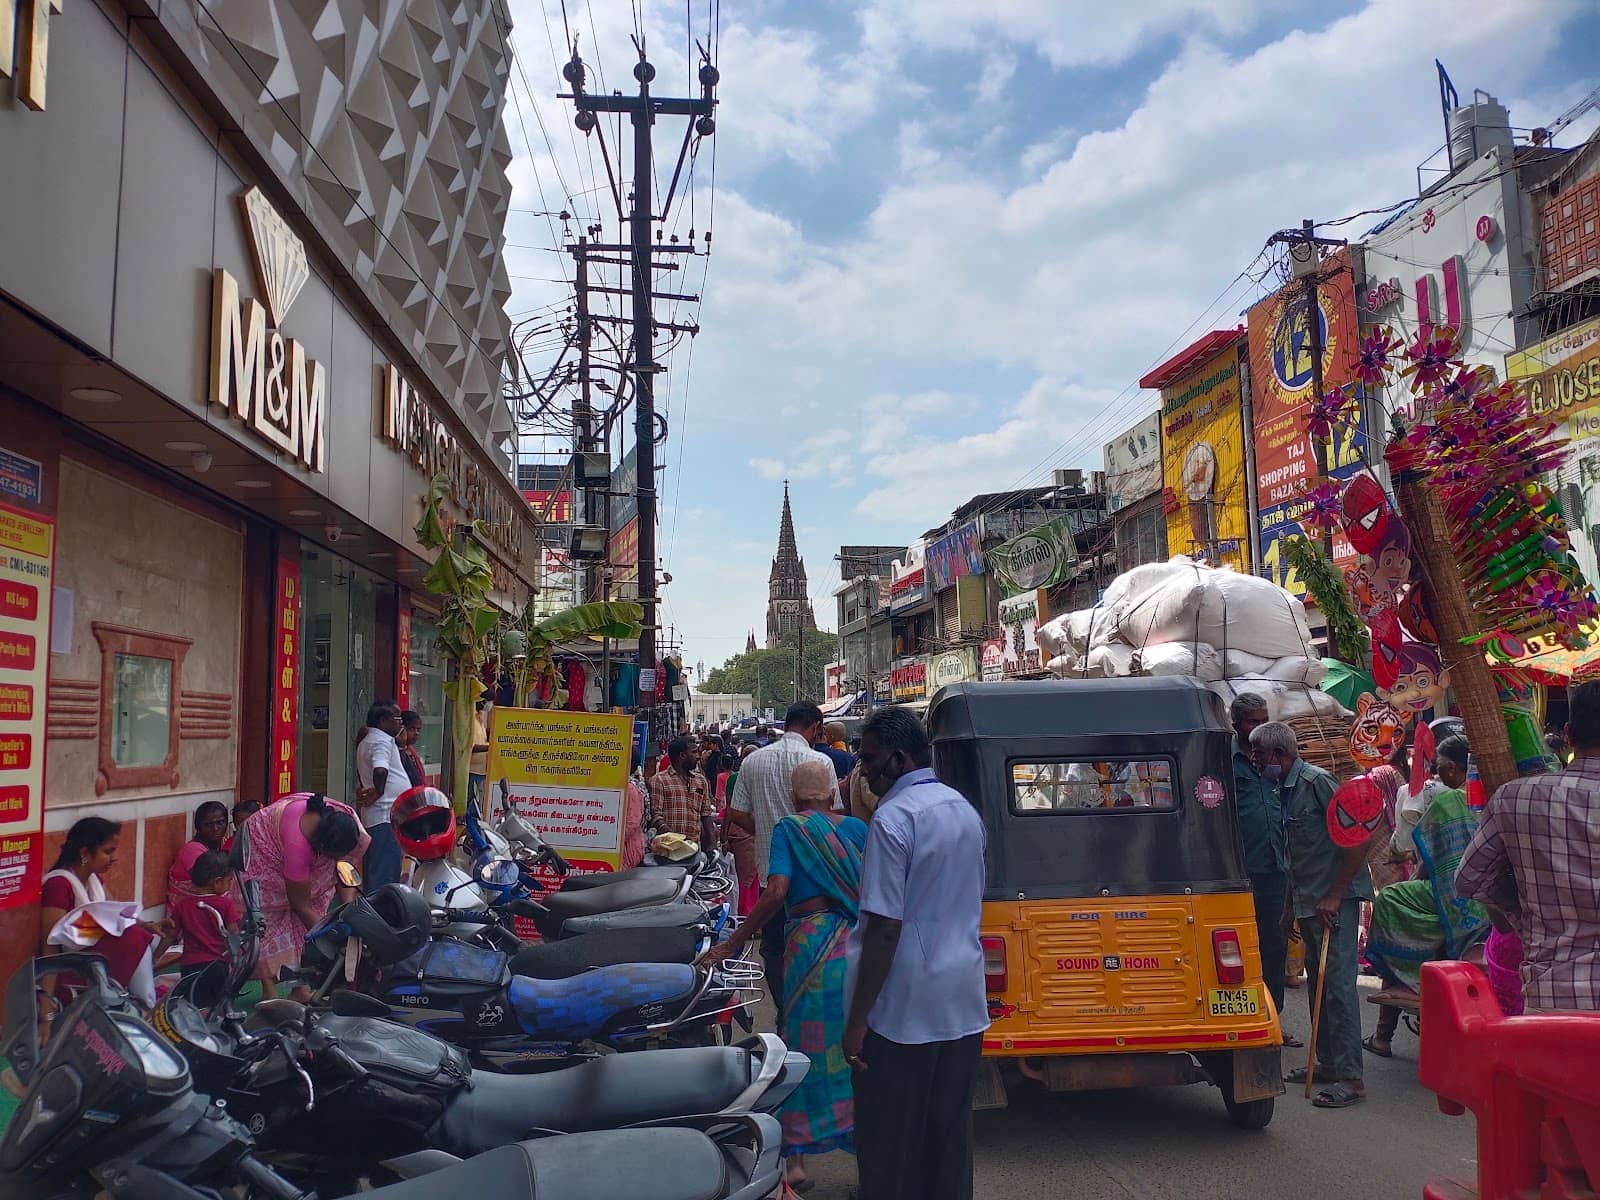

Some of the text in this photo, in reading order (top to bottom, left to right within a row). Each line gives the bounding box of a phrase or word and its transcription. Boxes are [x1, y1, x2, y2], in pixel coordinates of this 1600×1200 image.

[1287, 440, 1305, 460] TAJ
[1260, 460, 1306, 488] SHOPPING
[401, 614, 409, 695] MANGAL
[1070, 910, 1148, 921] FOR HIRE
[1056, 957, 1099, 971] SOUND
[1124, 956, 1160, 970] HORN
[401, 994, 430, 1006] Hero
